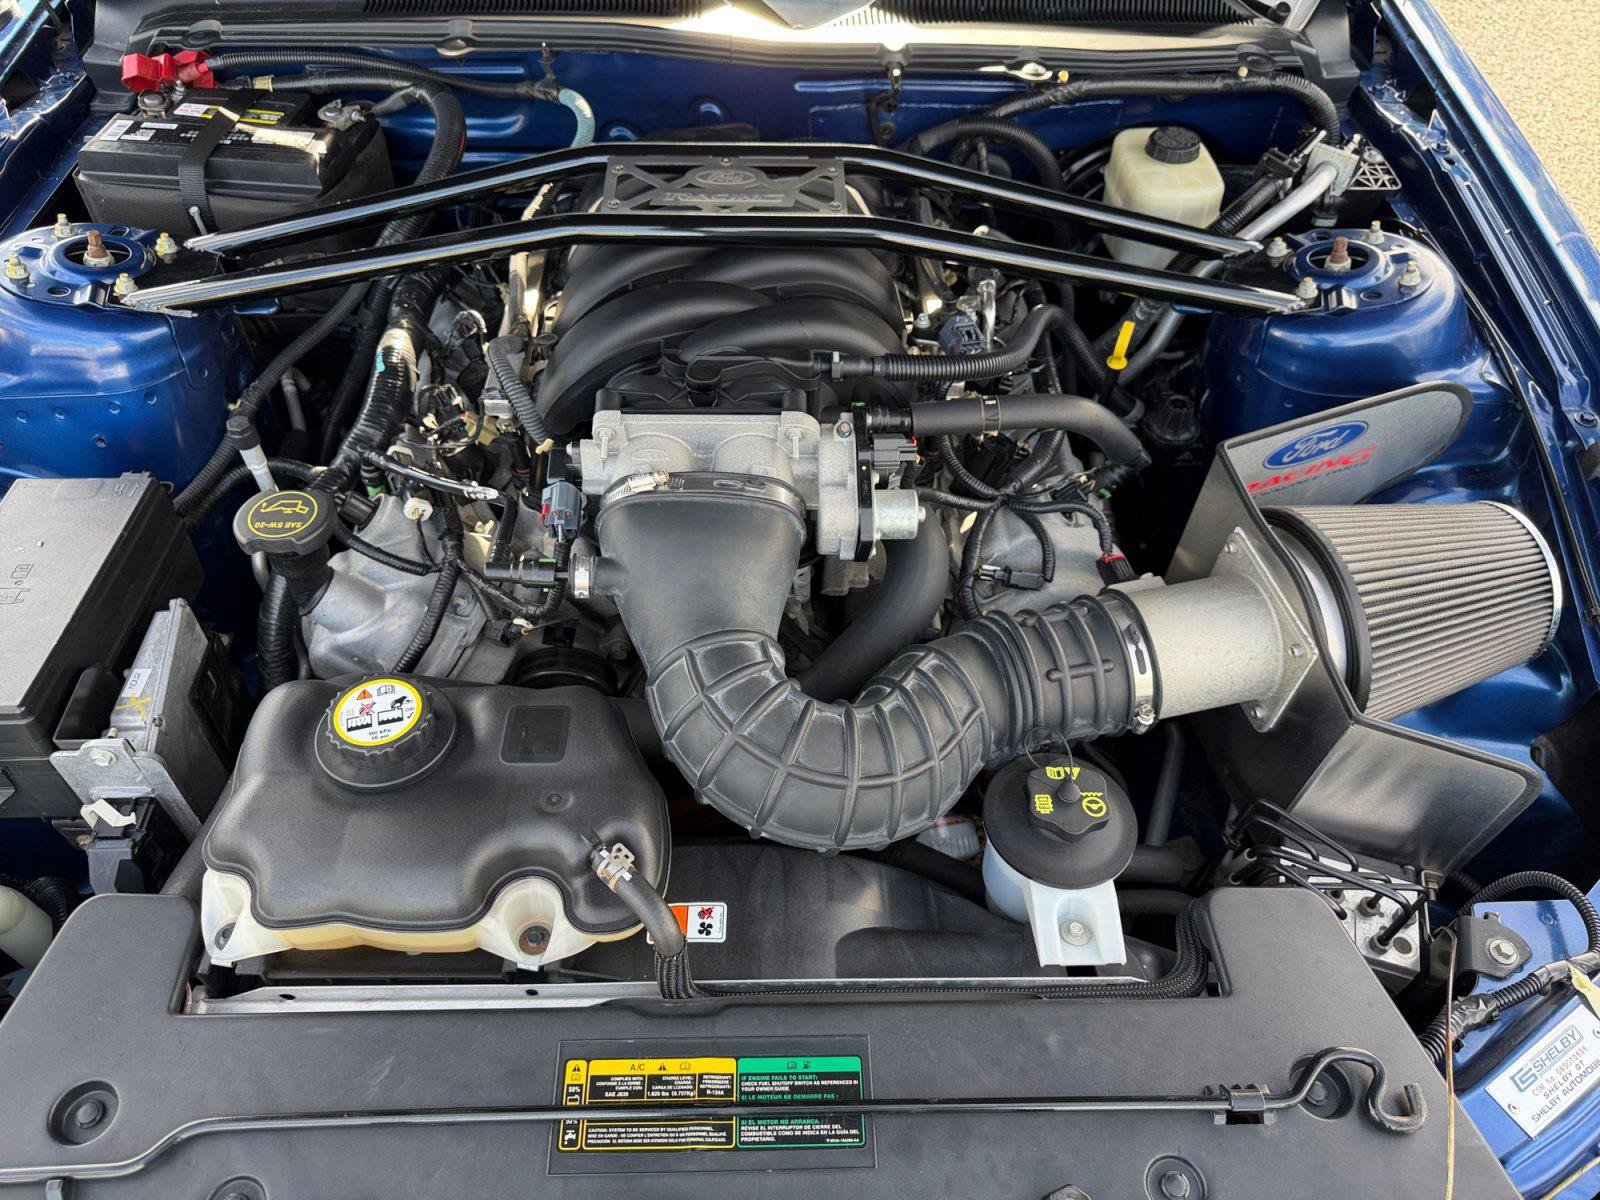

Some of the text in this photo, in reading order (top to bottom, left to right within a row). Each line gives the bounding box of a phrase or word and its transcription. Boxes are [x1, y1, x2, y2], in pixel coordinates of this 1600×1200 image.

[1282, 428, 1351, 462] Ford
[254, 521, 283, 529] 5W-20
[1535, 1028, 1578, 1073] SHELBY
[629, 1063, 646, 1071] A/C
[1543, 1070, 1573, 1099] SHELBY
[1531, 1095, 1562, 1124] SHELBY
